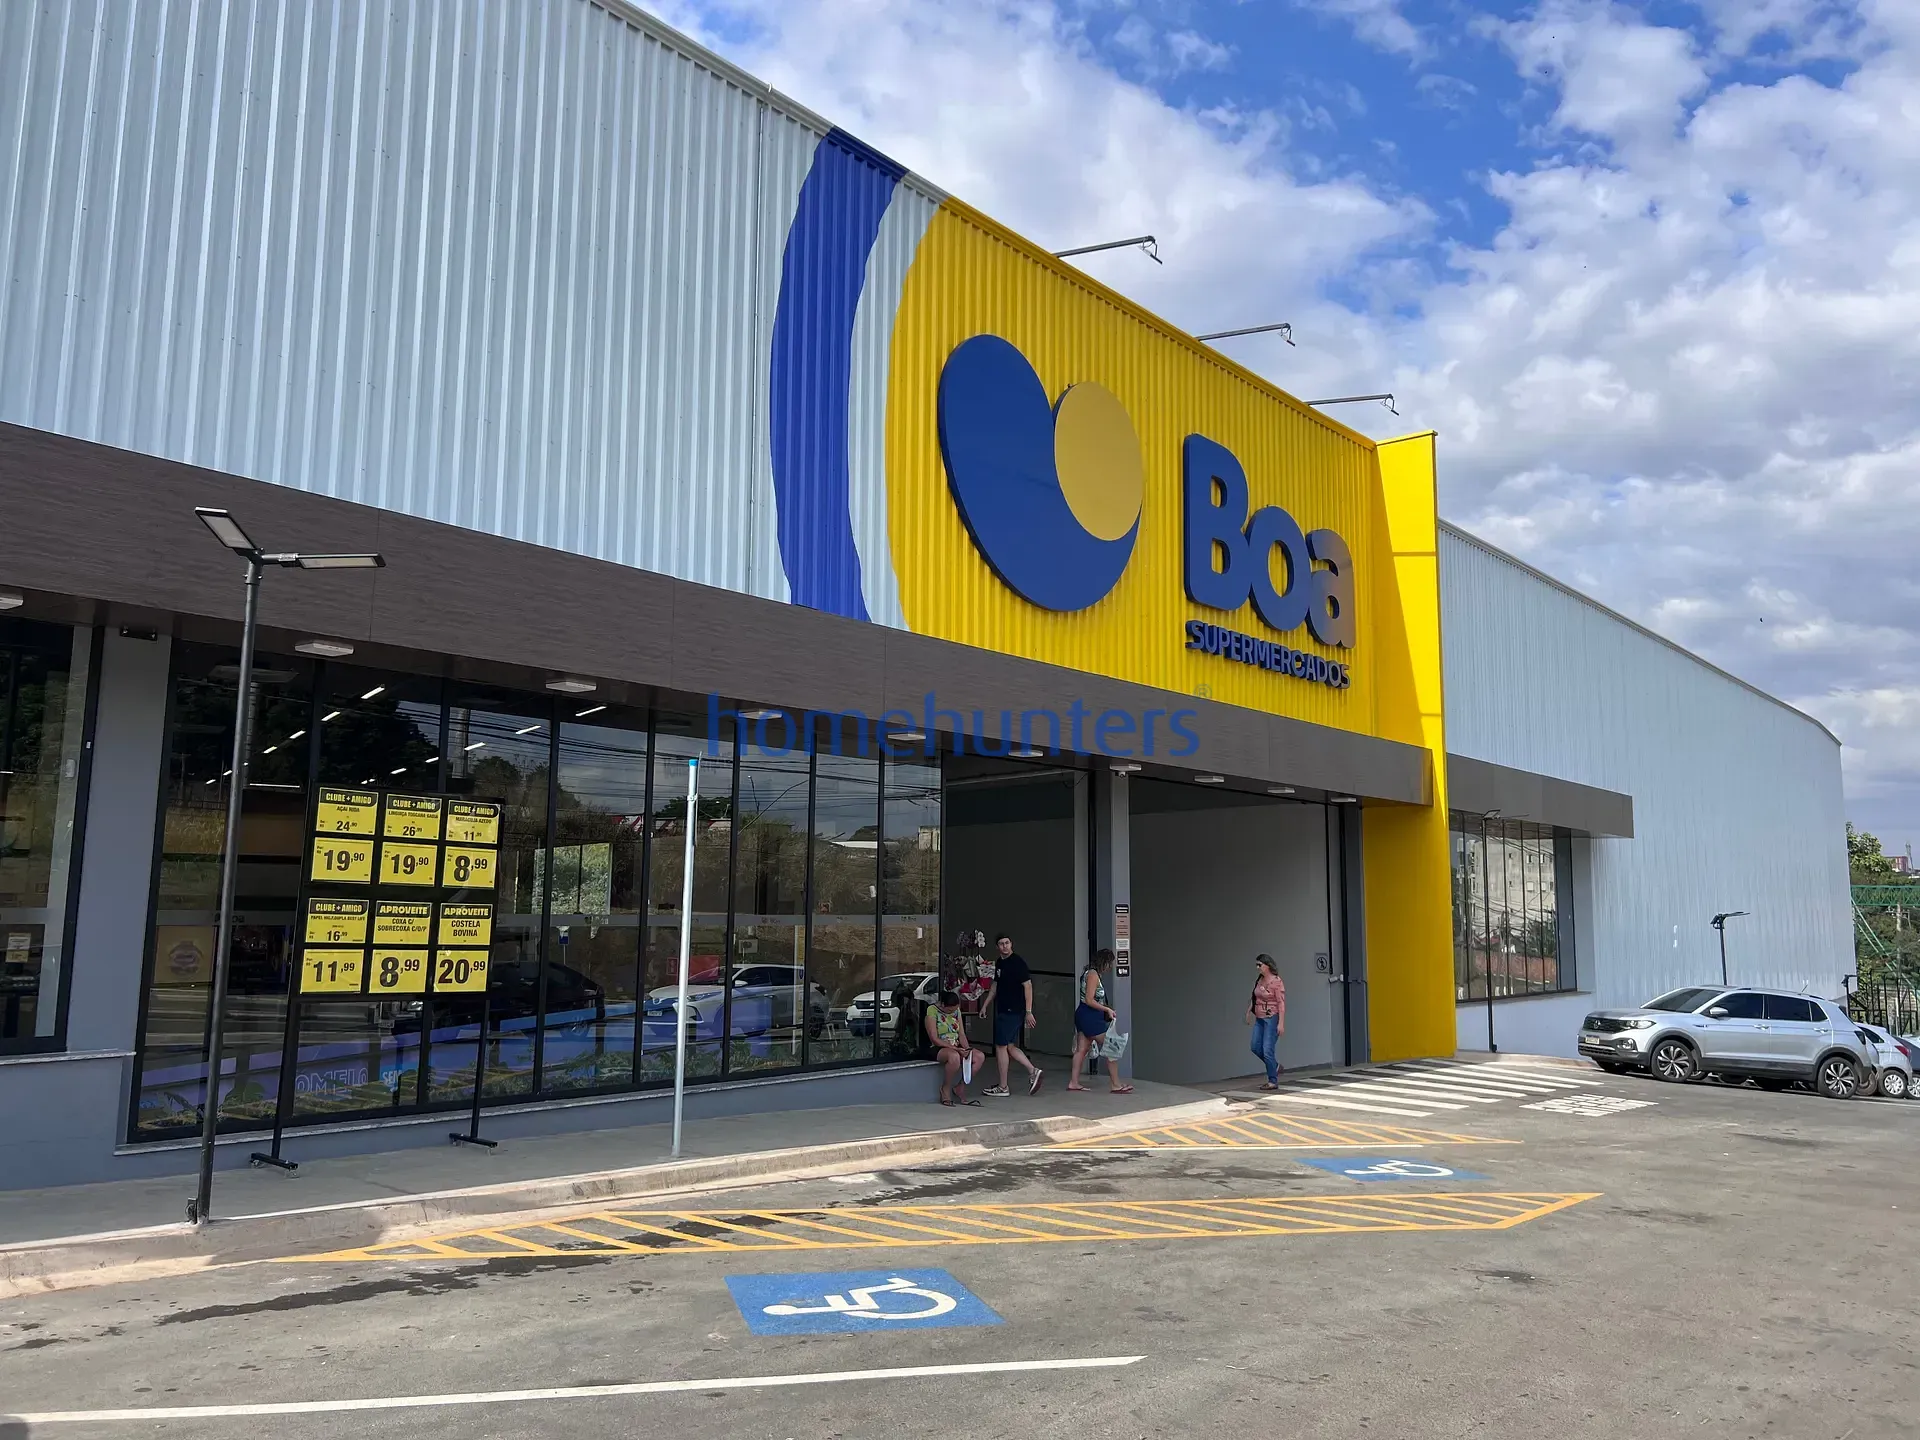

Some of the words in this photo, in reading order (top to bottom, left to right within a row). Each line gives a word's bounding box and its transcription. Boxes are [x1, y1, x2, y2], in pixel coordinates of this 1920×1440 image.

[1183, 432, 1356, 649] Boa
[1185, 620, 1350, 689] SUPERMERCADOS
[326, 793, 346, 802] CLUBE
[351, 795, 372, 804] AMIGO
[393, 799, 411, 808] CLUBE
[417, 801, 436, 810] AMIGO
[454, 805, 471, 813] CLUBE
[323, 849, 365, 871] 19,90
[390, 853, 429, 874] 19,90
[453, 855, 488, 882] 8,99
[315, 903, 336, 911] CLUBE
[341, 904, 362, 912] AMIGO
[380, 905, 428, 915] APROVEITE
[443, 907, 489, 916] APROVEITE
[451, 920, 481, 928] COSTELA
[453, 929, 478, 937] BOVINA
[313, 960, 355, 982] 11,99
[379, 956, 420, 987] 8,99
[437, 959, 486, 984] 20,99
